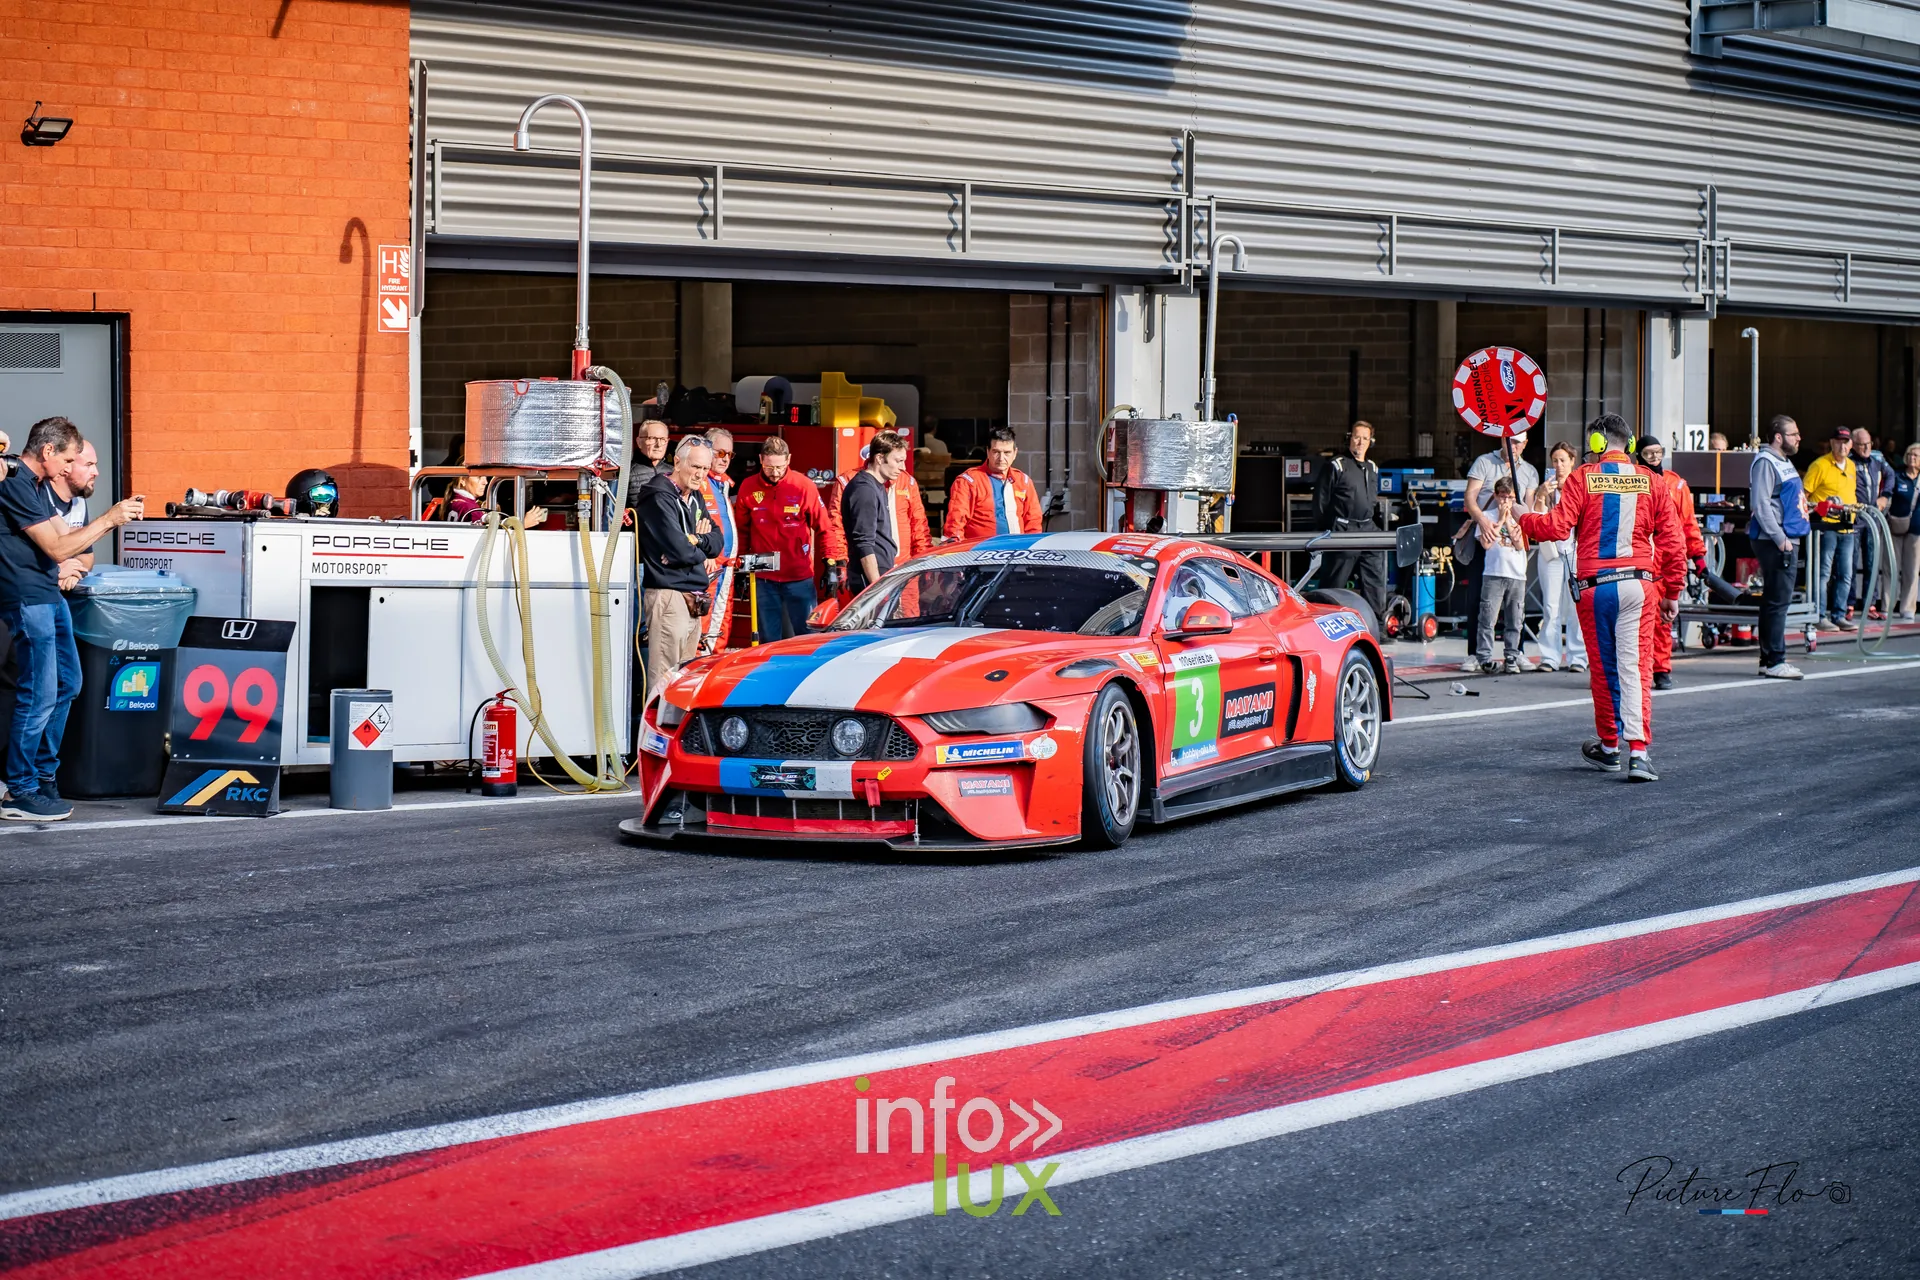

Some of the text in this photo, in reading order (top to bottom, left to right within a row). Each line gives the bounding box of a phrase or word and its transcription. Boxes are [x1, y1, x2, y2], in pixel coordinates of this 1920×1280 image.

[382, 251, 397, 274] H
[1503, 364, 1514, 388] Ford
[1469, 358, 1490, 430] VANSPRINGEL
[1689, 429, 1705, 451] 12
[1612, 477, 1648, 485] RACING
[123, 531, 216, 546] PORSCHE
[312, 535, 449, 551] PORSCHE
[123, 557, 173, 570] MOTORSPORT
[311, 562, 389, 576] MOTORSPORT
[1320, 617, 1349, 637] HELP
[128, 641, 160, 652] Belcyco
[1178, 652, 1214, 668] 100series.be
[128, 701, 156, 710] Belcyco
[183, 664, 279, 743] 99
[1189, 677, 1204, 738] 3
[1224, 690, 1274, 719] MAYAMI
[962, 746, 1015, 757] MICHELIN
[961, 779, 1010, 790] MAYAMI
[225, 787, 269, 802] RKC
